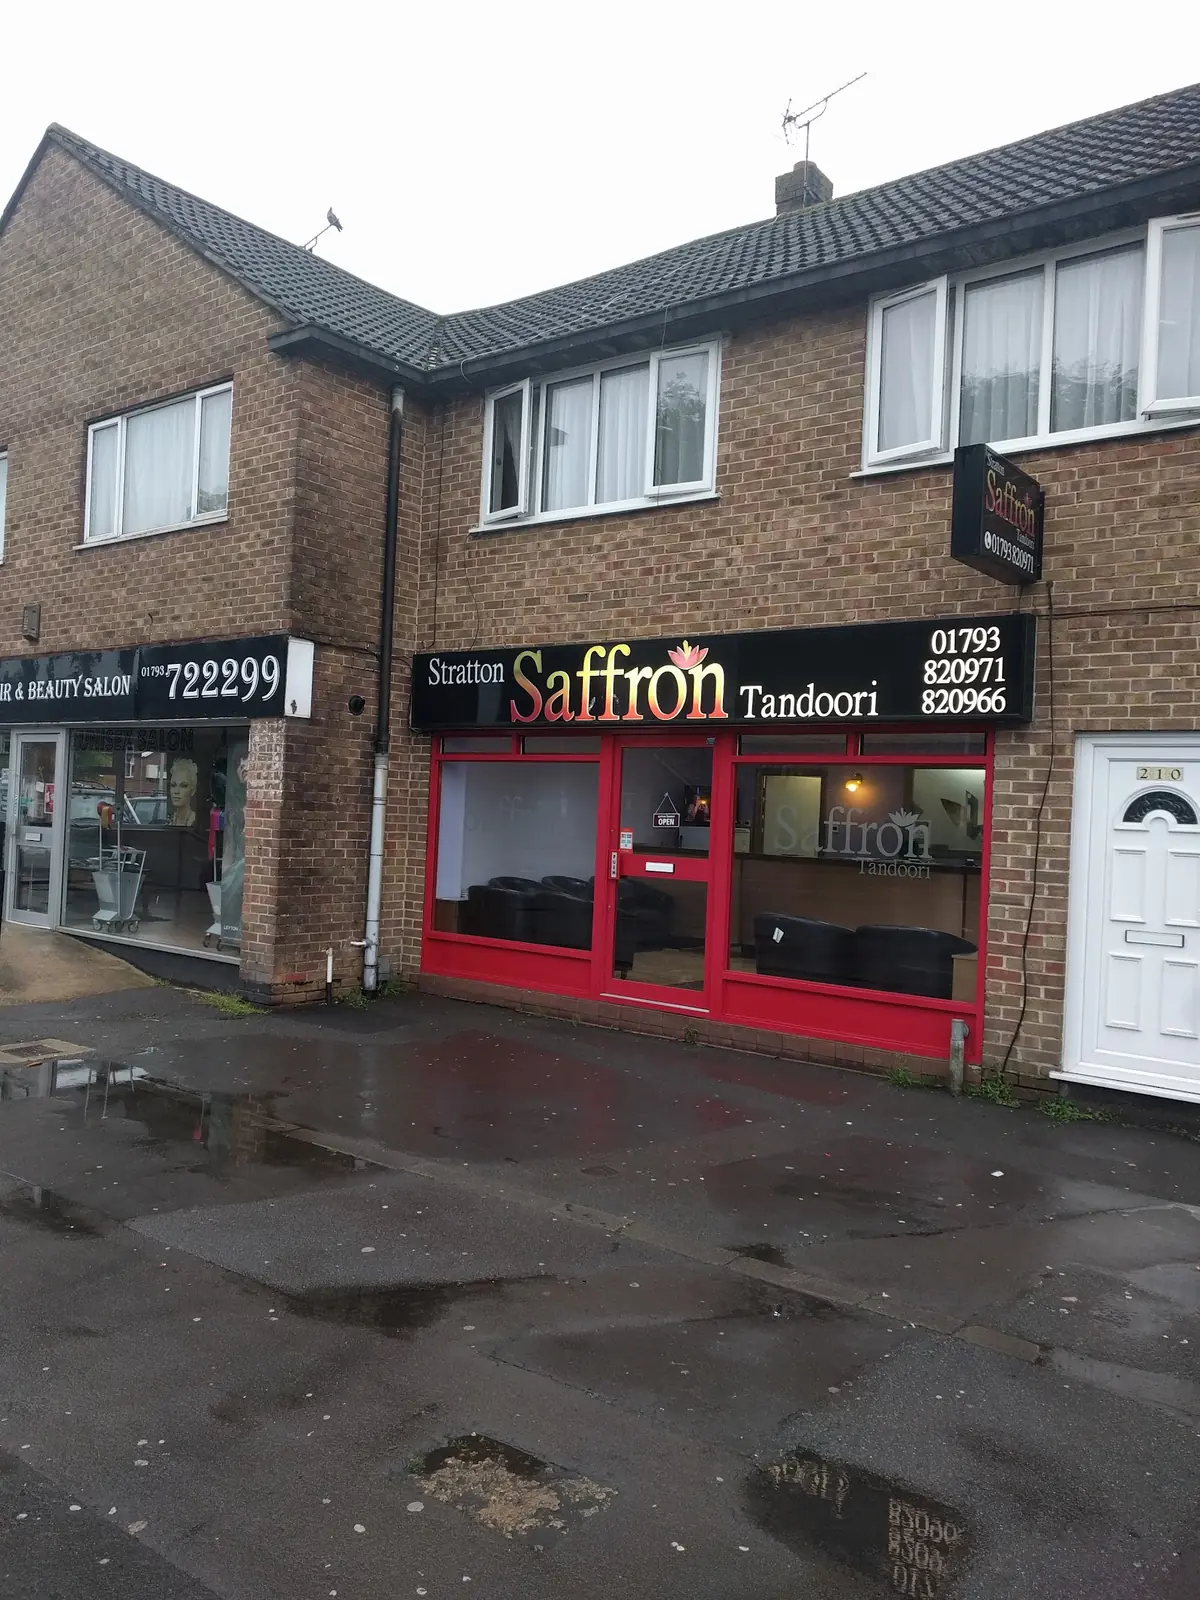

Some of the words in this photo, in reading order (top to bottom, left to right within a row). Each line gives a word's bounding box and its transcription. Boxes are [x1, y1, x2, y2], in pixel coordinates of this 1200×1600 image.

[985, 469, 1035, 538] Saffron
[991, 533, 1011, 561] 01793
[1012, 545, 1034, 574] 820971
[931, 626, 1001, 654] 01793
[141, 665, 164, 677] 01793
[166, 655, 280, 702] 722299
[428, 658, 505, 686] Stratton
[510, 644, 729, 723] Saffron
[740, 680, 879, 719] Tandoori
[923, 656, 1006, 685] 820971
[14, 681, 25, 700] &
[28, 674, 84, 700] BEAUTY
[83, 675, 131, 698] SALON
[921, 687, 1007, 715] 820966
[138, 728, 194, 752] SALON
[1140, 768, 1181, 780] 210
[658, 818, 675, 826] OPEN
[774, 804, 933, 860] Saffron
[855, 858, 932, 880] Tandoori
